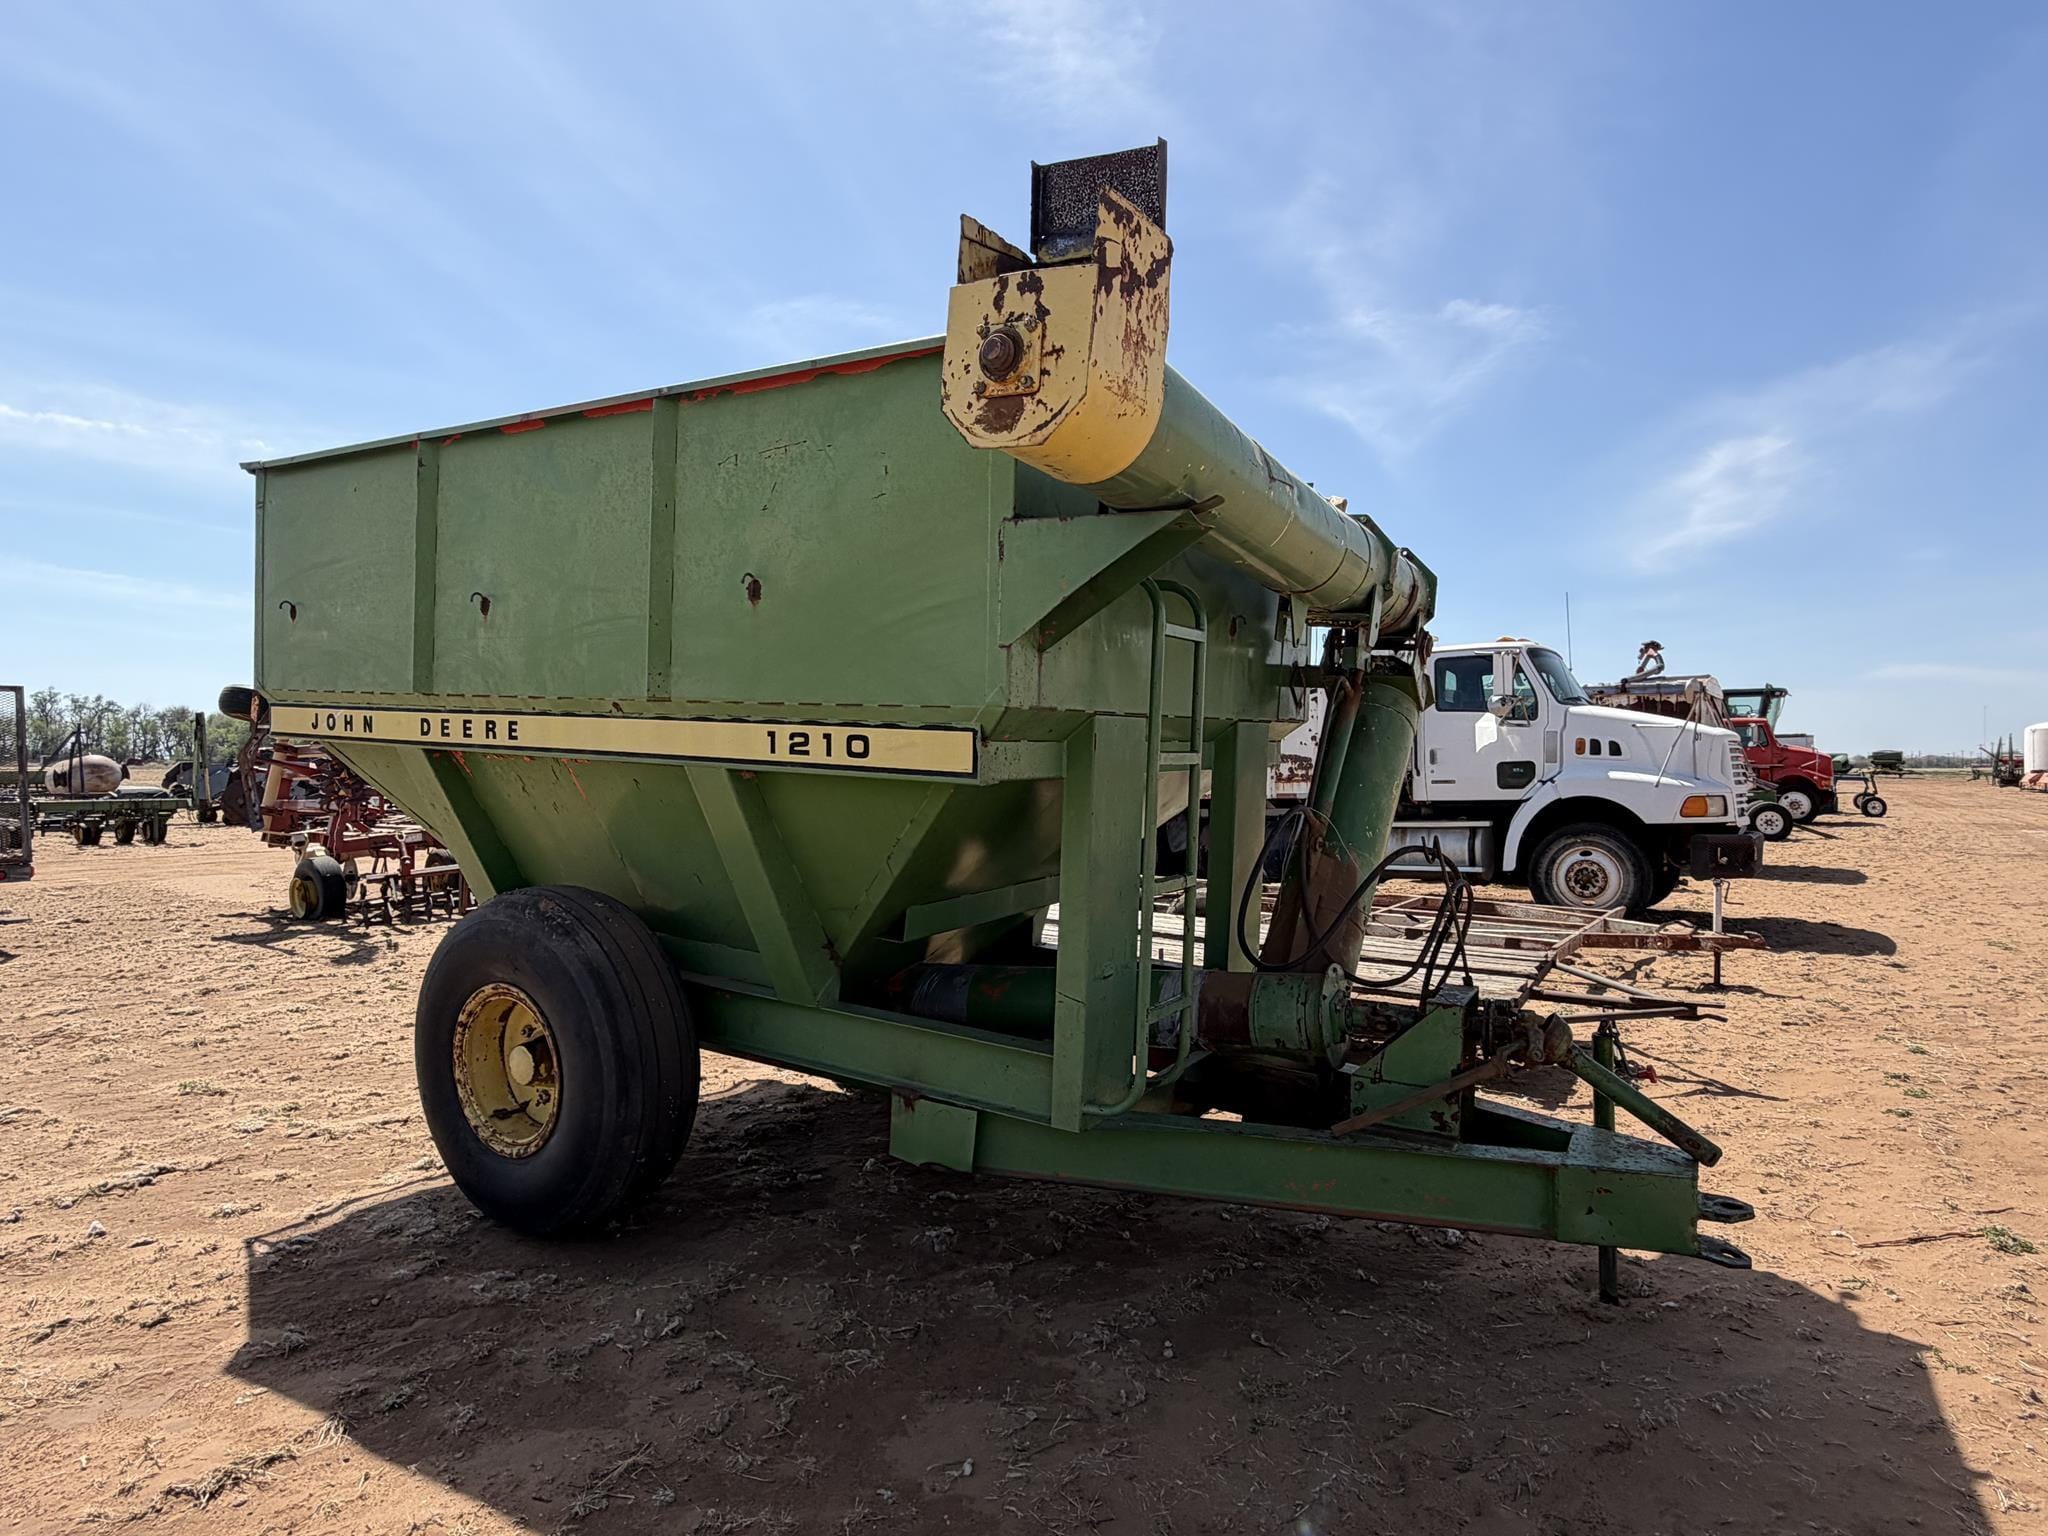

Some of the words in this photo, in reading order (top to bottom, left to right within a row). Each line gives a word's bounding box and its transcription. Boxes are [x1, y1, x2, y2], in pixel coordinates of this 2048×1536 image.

[311, 712, 373, 733] JOHN
[420, 717, 519, 741] DEERE
[766, 730, 870, 759] 1210
